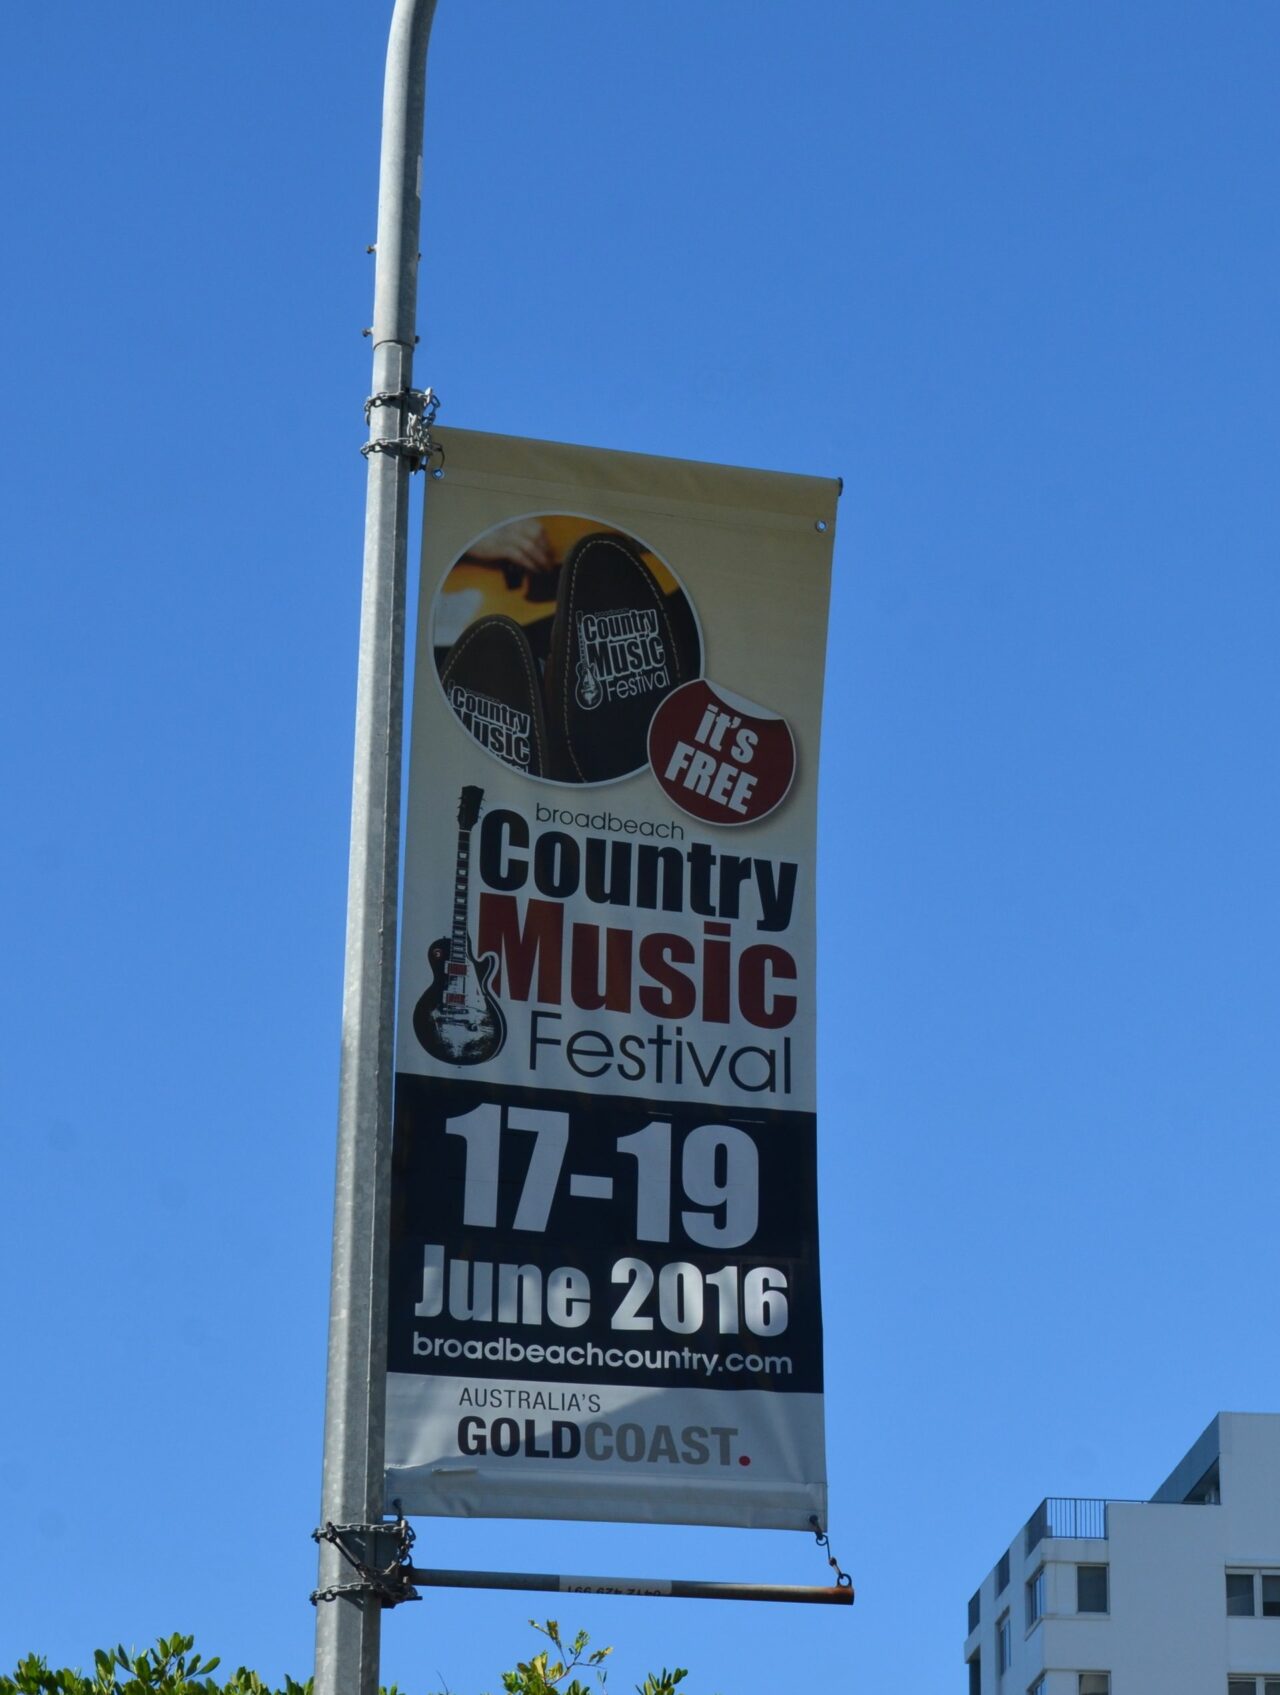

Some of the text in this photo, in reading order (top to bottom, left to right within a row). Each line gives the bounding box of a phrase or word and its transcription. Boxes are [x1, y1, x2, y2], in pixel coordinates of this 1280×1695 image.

[582, 608, 659, 644] Country
[585, 634, 666, 681] Music
[606, 665, 671, 702] Festival
[451, 685, 531, 737] Country
[695, 704, 758, 764] it's
[664, 740, 758, 815] FREE
[535, 802, 685, 841] broadbeach
[479, 808, 798, 932] Country
[477, 892, 798, 1030] Music
[529, 1010, 792, 1094] Festival
[445, 1102, 760, 1249] 17-19
[414, 1243, 789, 1337] June 2016
[412, 1331, 793, 1376] broadbeachcountry.com
[459, 1387, 601, 1413] AUSTRALIA'S
